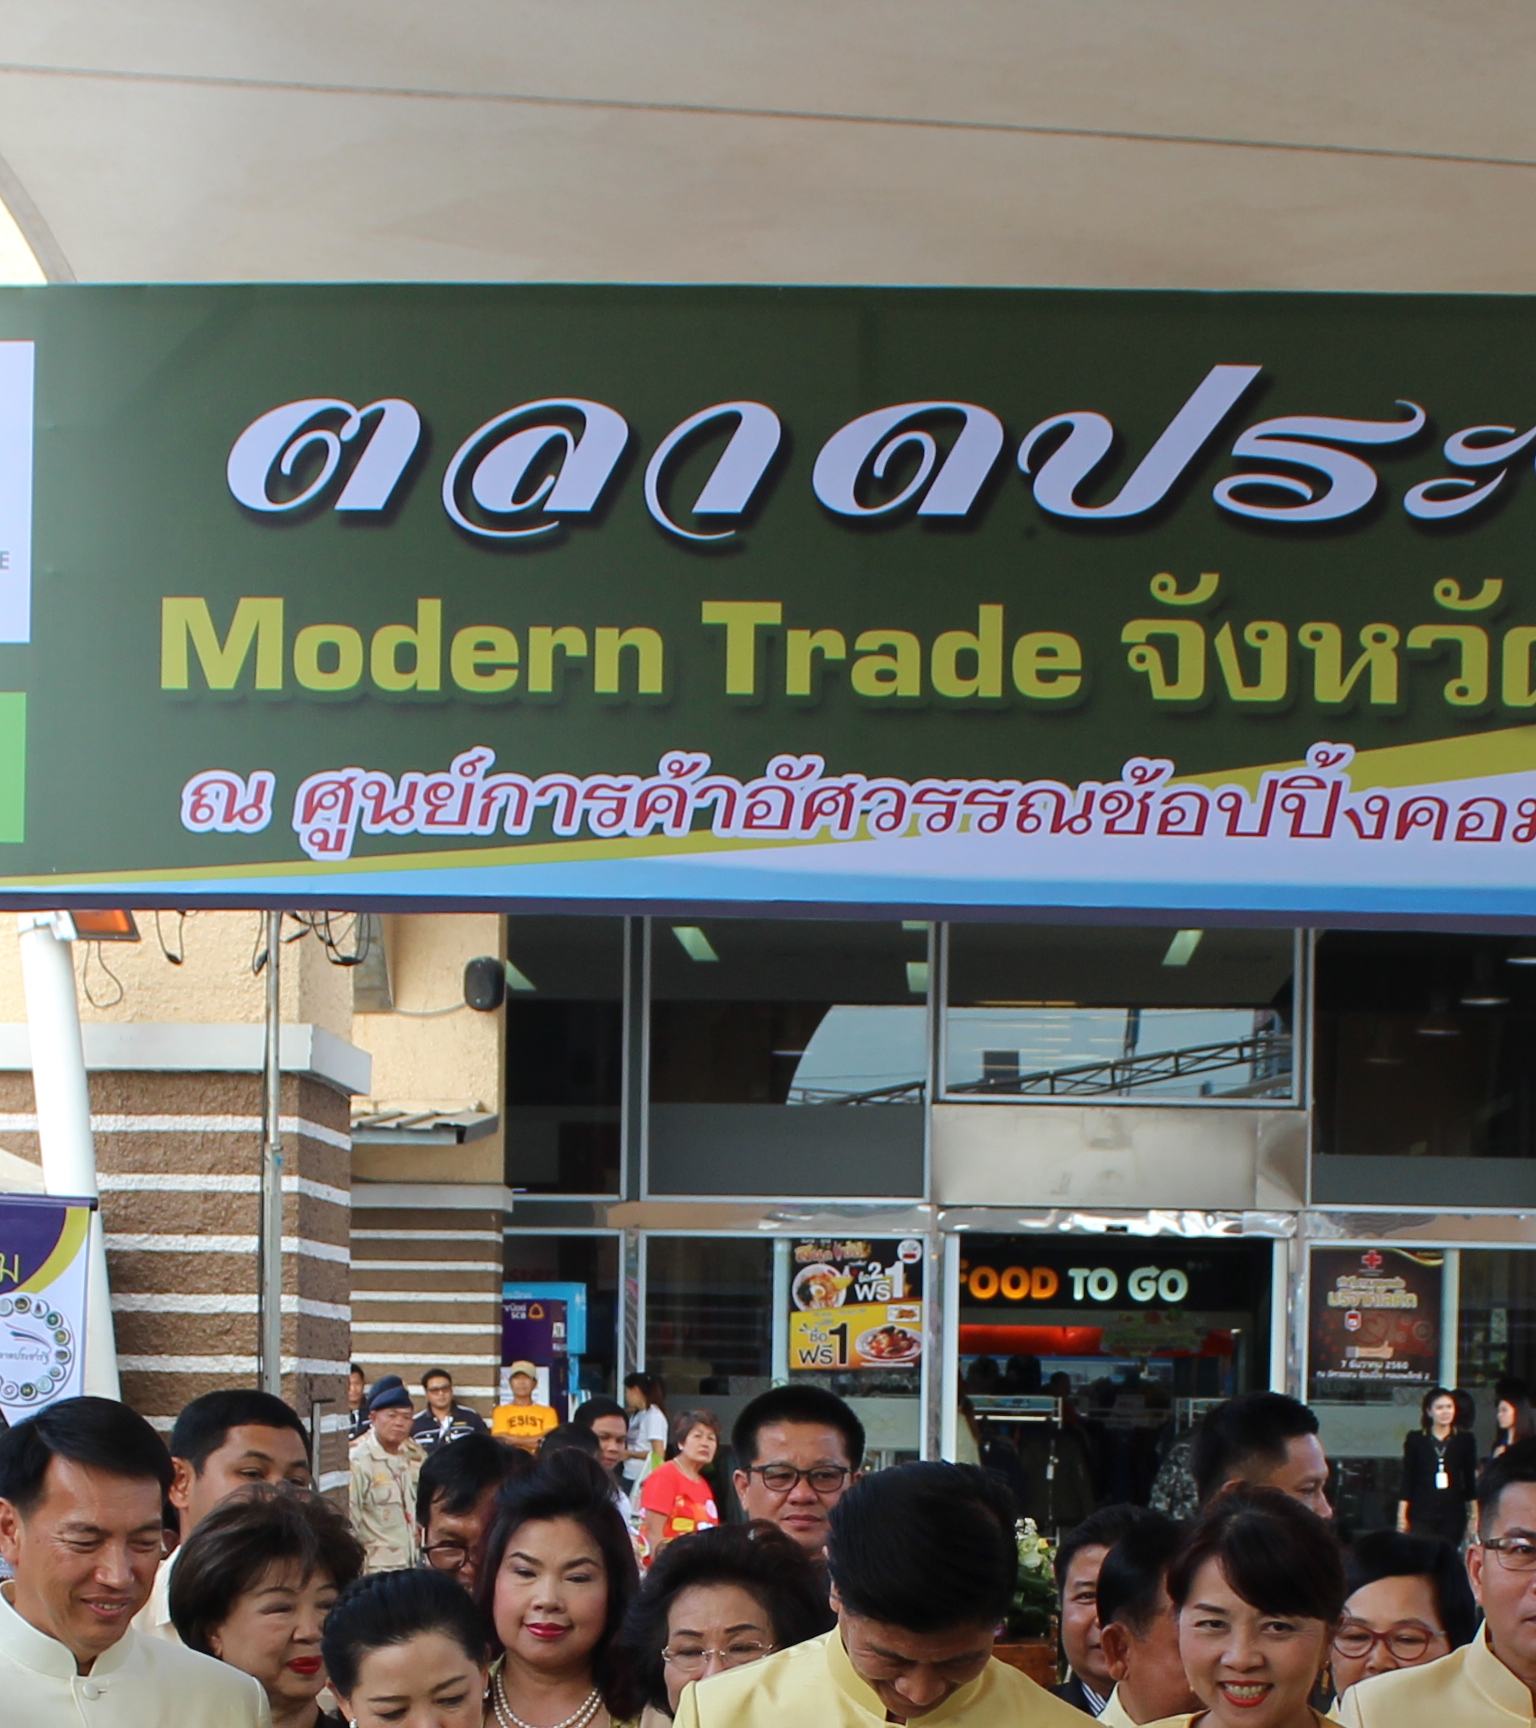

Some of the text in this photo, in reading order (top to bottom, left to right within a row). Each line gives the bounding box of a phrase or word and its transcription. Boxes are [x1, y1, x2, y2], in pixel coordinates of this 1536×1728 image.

[160, 596, 664, 696] Modern
[701, 600, 1082, 700] Trade
[183, 771, 270, 832] ณ
[884, 1260, 904, 1299] 1
[1068, 1267, 1118, 1301] TO
[1128, 1265, 1189, 1302] GO
[829, 1322, 847, 1365] 1
[507, 1415, 545, 1431] ESIST
